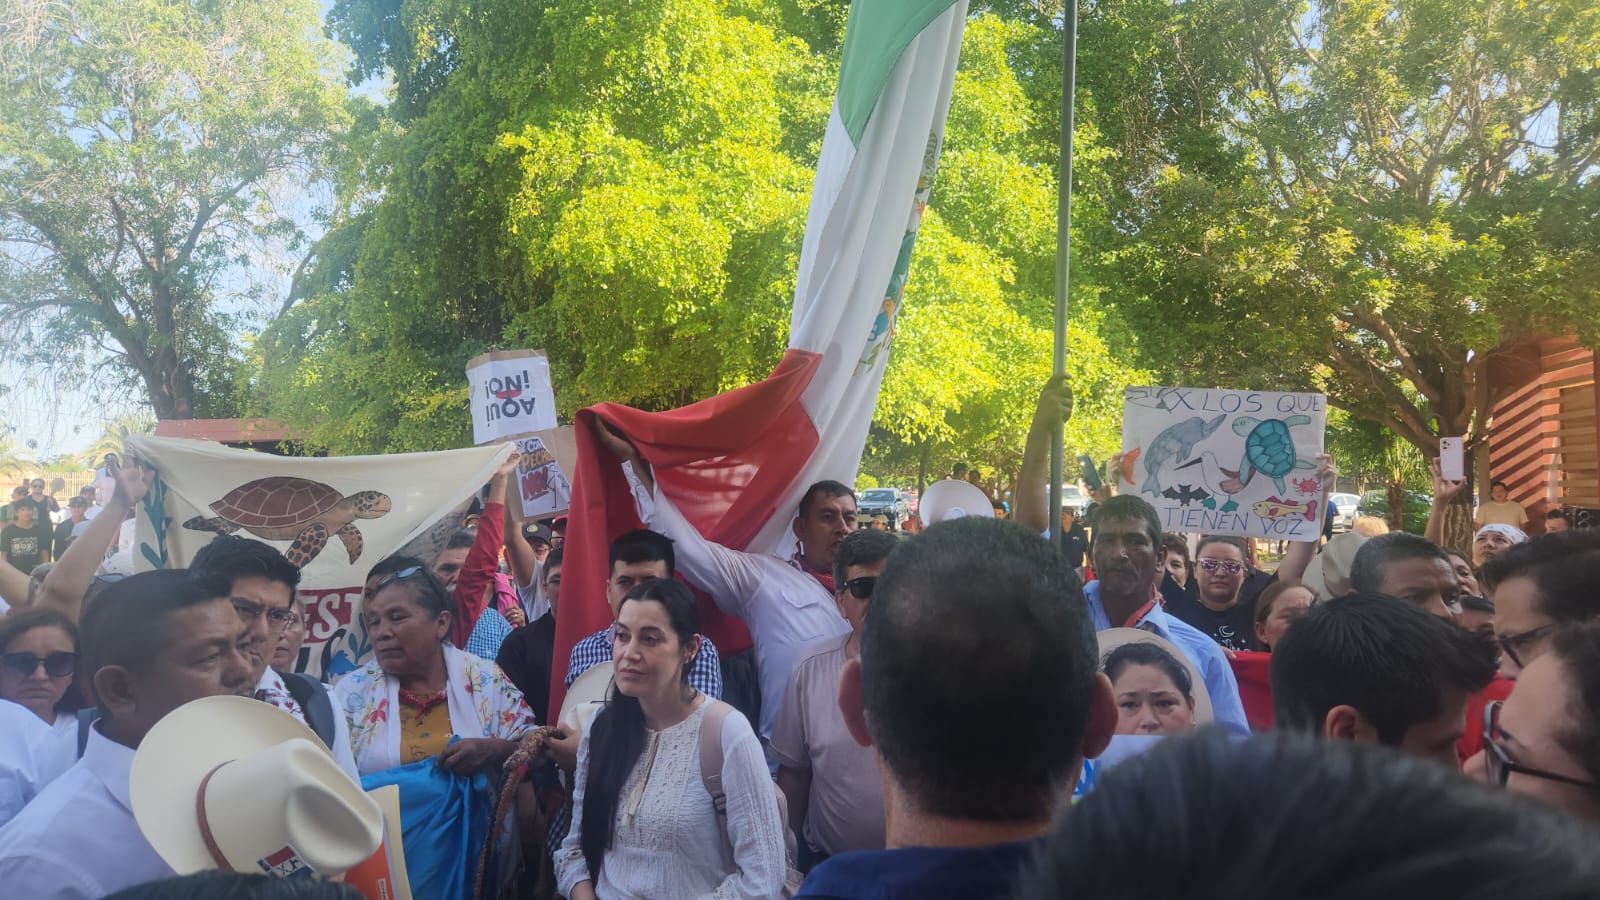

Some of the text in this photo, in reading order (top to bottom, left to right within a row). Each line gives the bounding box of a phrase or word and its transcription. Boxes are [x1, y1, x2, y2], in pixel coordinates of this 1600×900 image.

[1202, 393, 1263, 413] LOS
[1277, 393, 1322, 415] QUE
[1163, 507, 1304, 535] TIENEN VOZ
